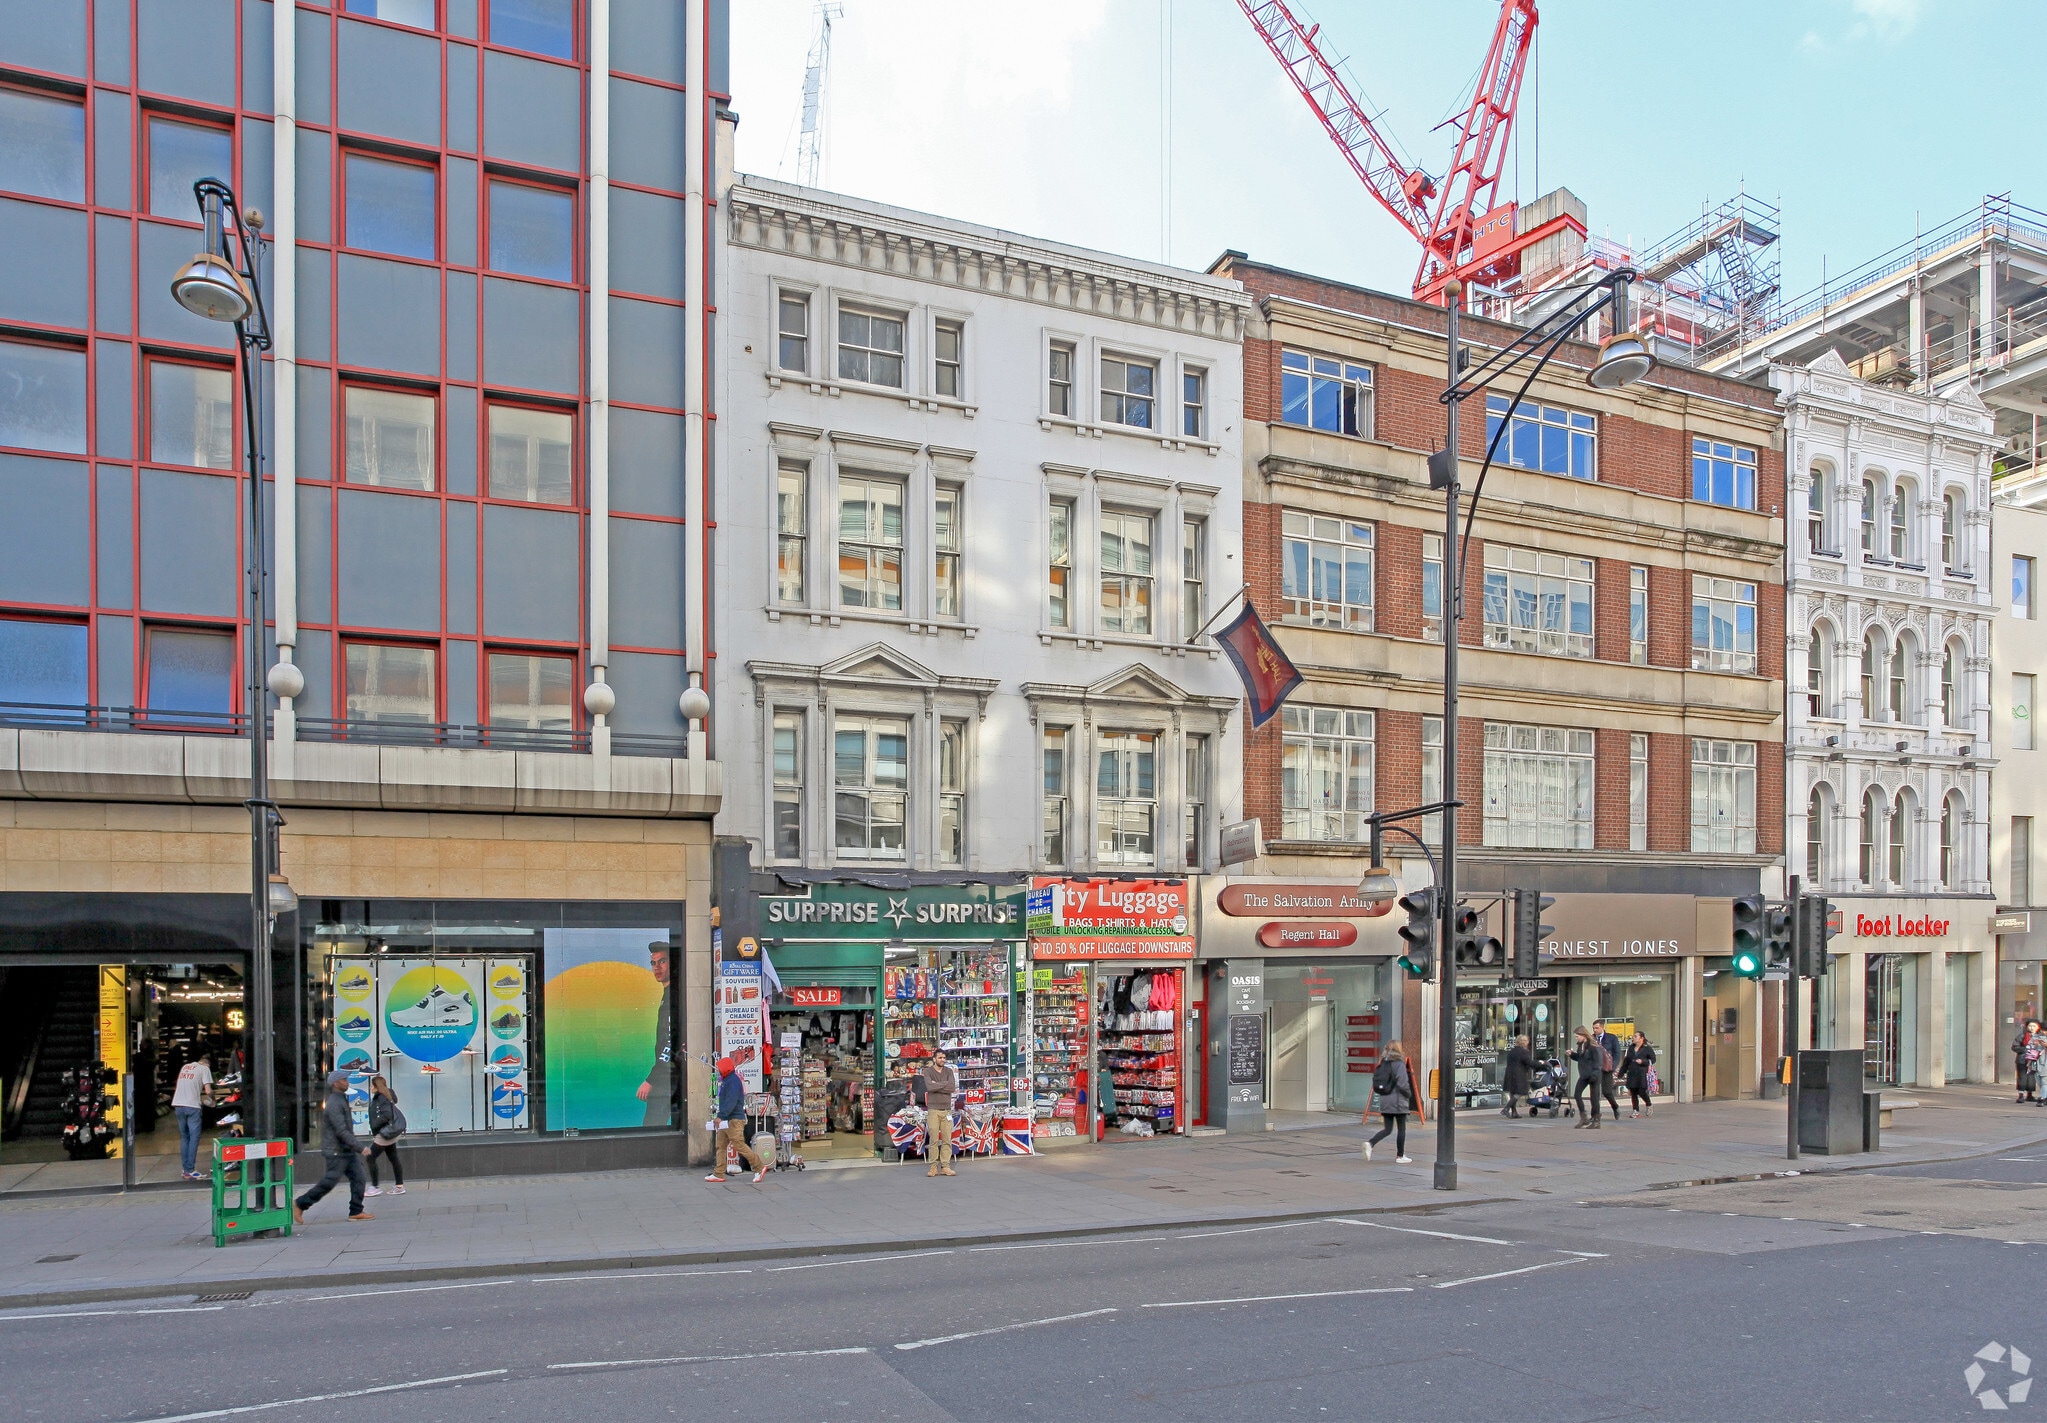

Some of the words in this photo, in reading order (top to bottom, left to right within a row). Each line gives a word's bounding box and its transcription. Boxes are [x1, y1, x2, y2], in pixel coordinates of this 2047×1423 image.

[1473, 212, 1510, 241] HTC
[1028, 889, 1051, 900] BUREAU
[1061, 885, 1089, 913] ity
[1098, 884, 1179, 914] Luggage
[1035, 898, 1043, 906] DE
[1244, 893, 1269, 908] The
[1273, 893, 1333, 908] Salvation
[1339, 895, 1374, 911] Army
[769, 902, 879, 924] SURPRISE
[916, 903, 1018, 925] SURPRISE
[1028, 906, 1051, 917] CHANGE
[1069, 918, 1093, 927] BAGS
[1856, 913, 1892, 936] Foot
[1897, 913, 1950, 936] Locker
[1280, 929, 1315, 942] Regent
[1318, 929, 1340, 940] Hall
[1041, 943, 1053, 954] TO
[1055, 942, 1067, 954] 50
[1069, 943, 1077, 954] %
[1079, 942, 1096, 954] OFF
[1098, 942, 1137, 954] LUGGAGE
[1138, 941, 1192, 954] DOWNSTAIRS
[1622, 940, 1678, 955] JONES
[1231, 976, 1260, 985] OASIS
[1506, 979, 1548, 989] LONGINES
[796, 989, 838, 1003] SALE
